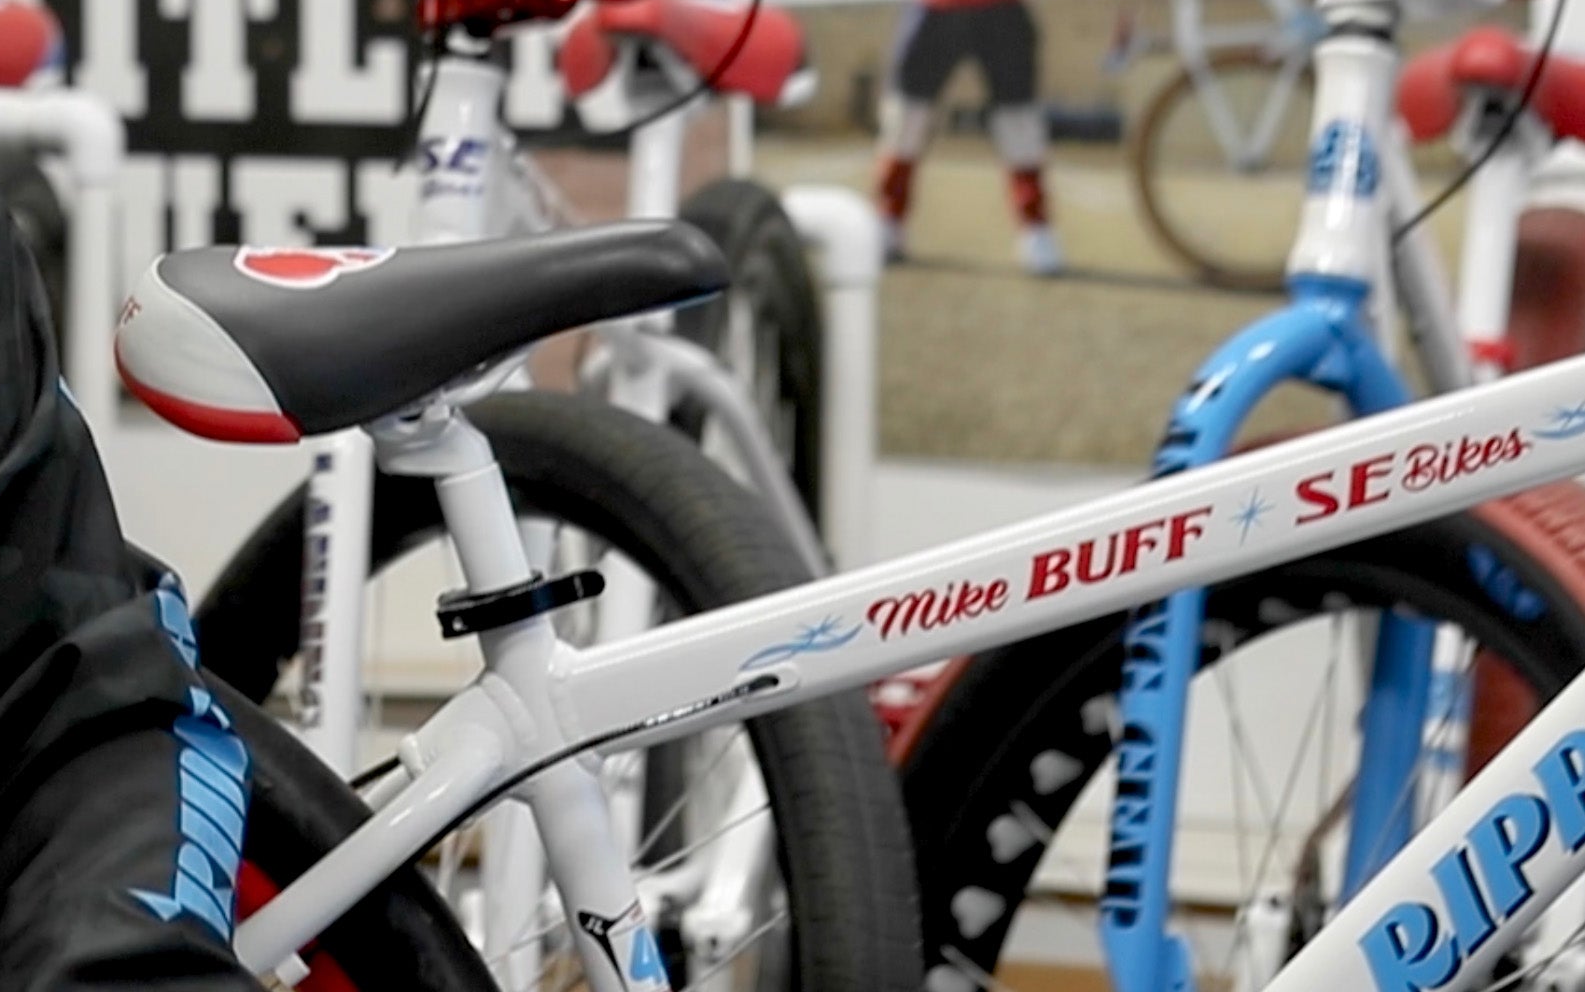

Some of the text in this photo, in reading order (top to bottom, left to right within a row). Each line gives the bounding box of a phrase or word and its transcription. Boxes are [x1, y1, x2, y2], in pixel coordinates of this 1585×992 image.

[867, 426, 1535, 642] Mike BUFF SE Bikes
